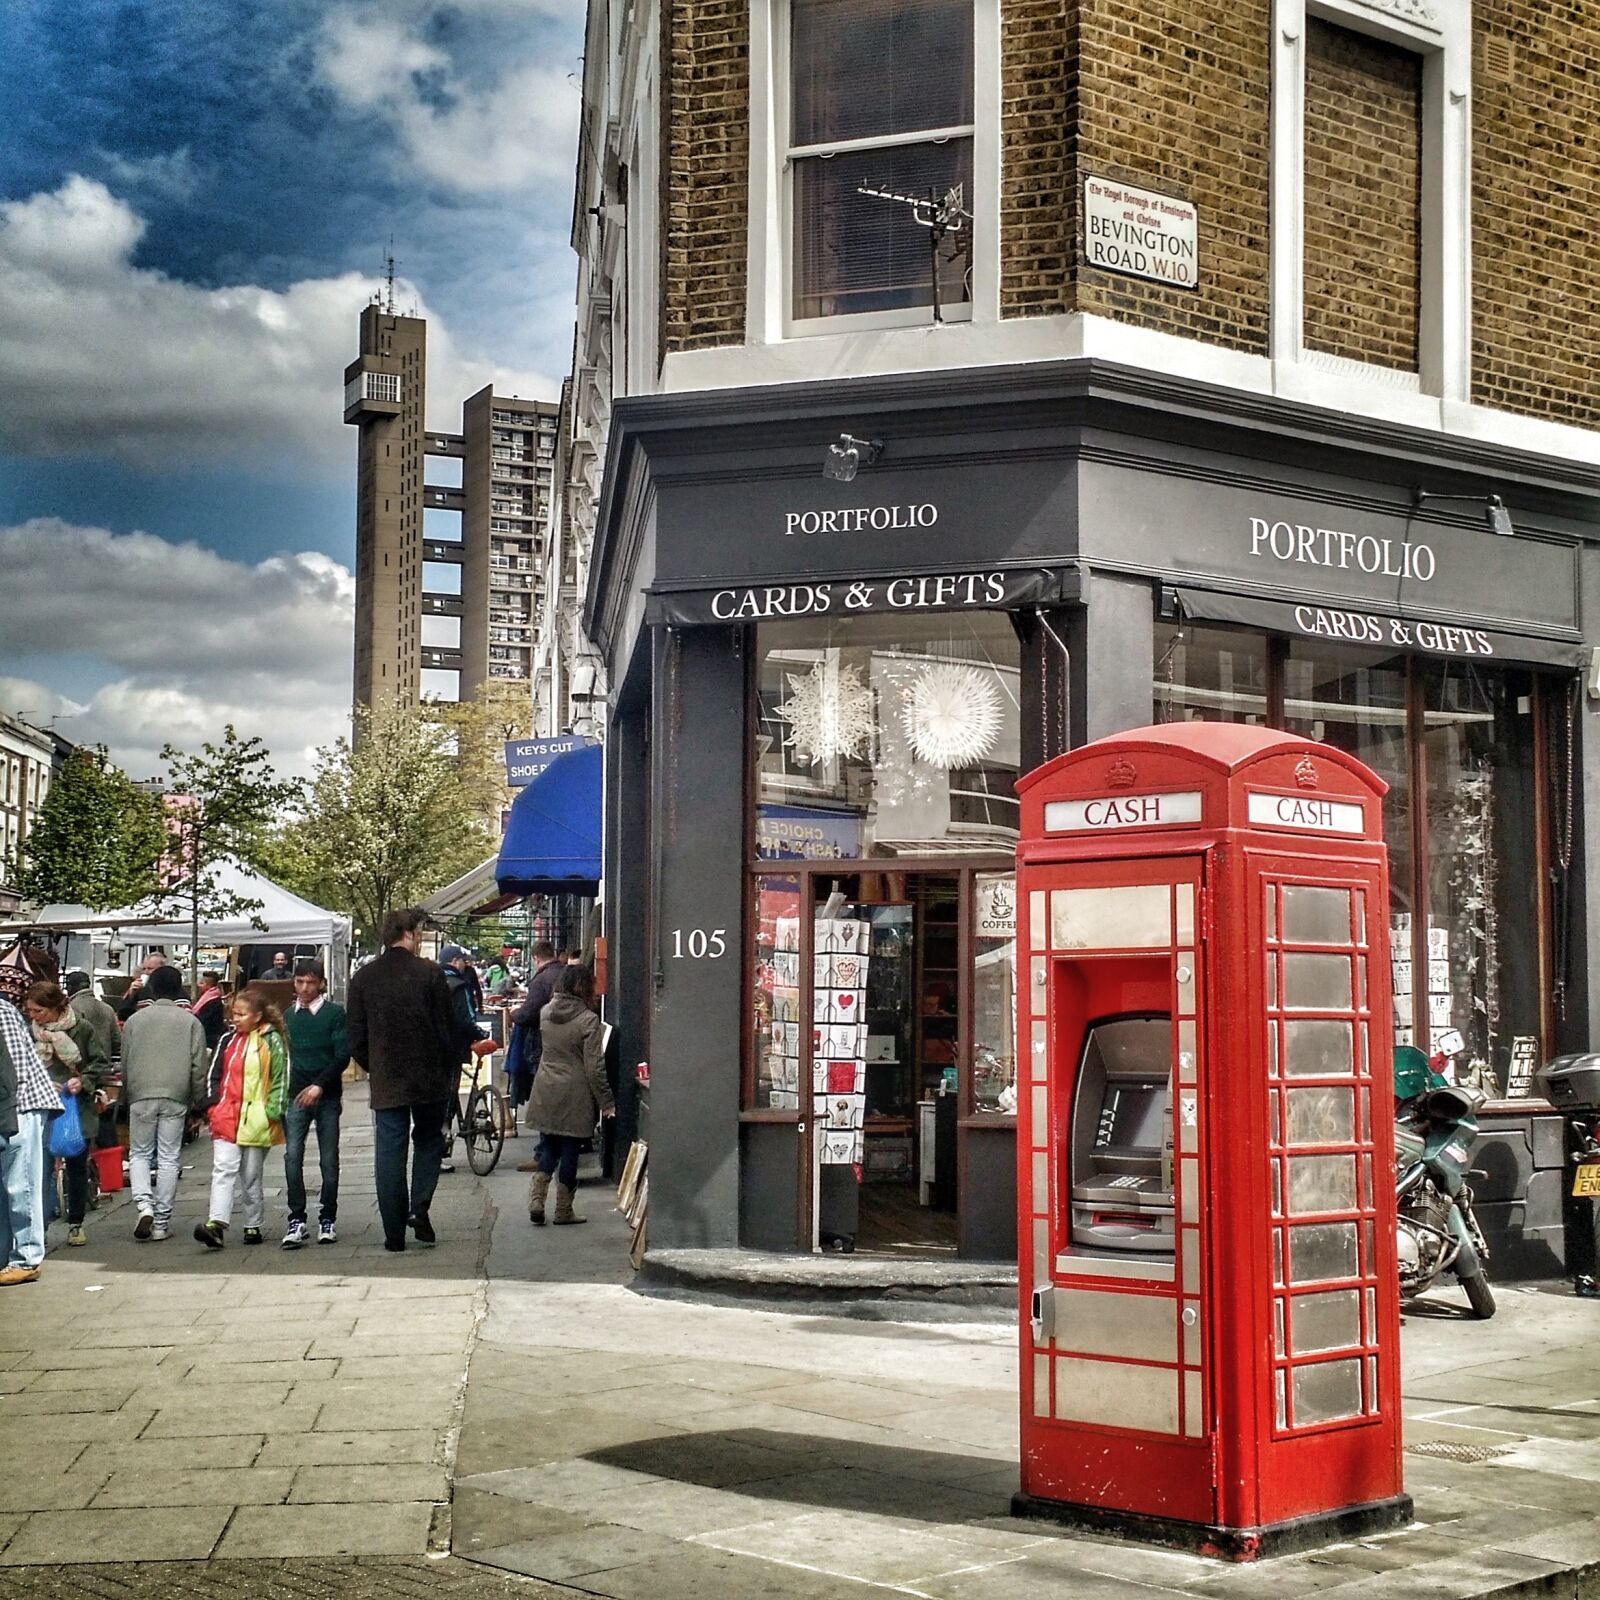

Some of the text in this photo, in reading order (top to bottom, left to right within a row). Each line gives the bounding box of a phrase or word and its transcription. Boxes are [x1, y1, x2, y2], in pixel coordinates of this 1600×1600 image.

[1089, 183, 1102, 195] The
[1124, 192, 1149, 210] Borough
[1151, 200, 1159, 210] of
[1160, 201, 1193, 221] Kensington
[1090, 215, 1194, 258] BEVINGTON
[785, 503, 938, 535] PORTFOLIO
[1249, 517, 1436, 581] PORTFOLIO
[710, 572, 1006, 619] CARDS & GIFTS
[1294, 605, 1494, 655] CARDS & GIFTS
[516, 742, 574, 756] KEYS CUT
[510, 764, 539, 777] SHOE
[1084, 797, 1161, 826] CASH
[1276, 797, 1334, 827] CASH
[672, 929, 726, 958] 105
[1580, 1180, 1600, 1192] EN
